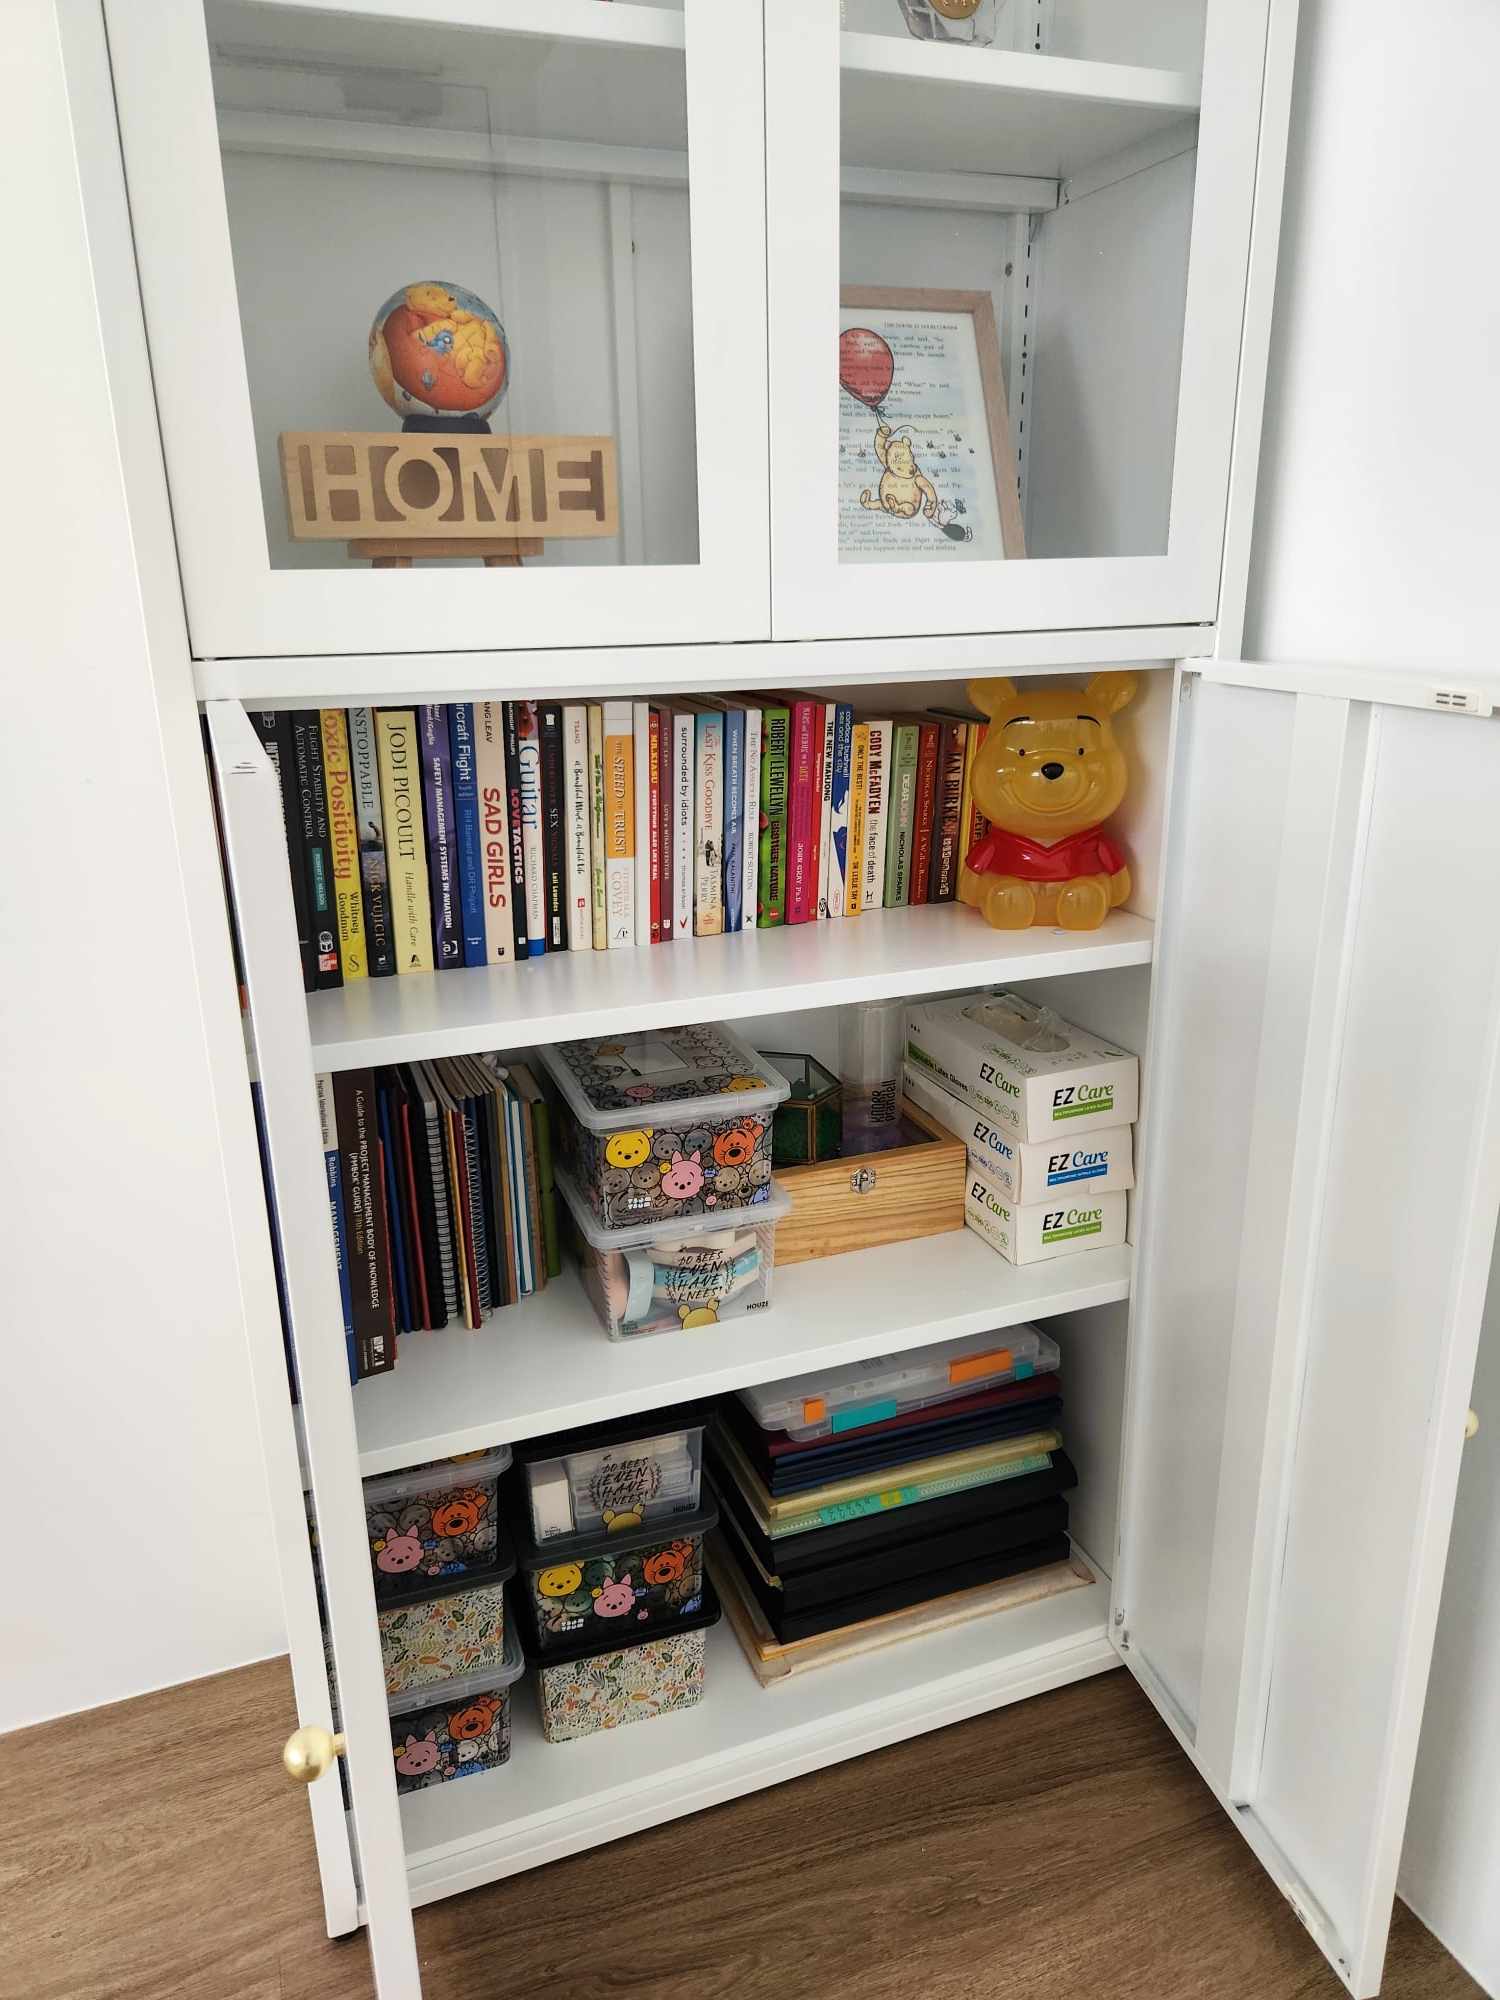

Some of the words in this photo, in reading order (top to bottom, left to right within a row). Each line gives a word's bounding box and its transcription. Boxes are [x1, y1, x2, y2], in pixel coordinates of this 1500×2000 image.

[303, 445, 602, 522] HOME
[455, 703, 469, 744] ircraft
[484, 702, 492, 719] ANG
[485, 720, 494, 743] LEAV
[704, 724, 716, 748] LAST
[770, 718, 785, 757] ROBERT
[826, 721, 834, 737] THE
[843, 711, 851, 742] candace
[309, 725, 319, 760] FLIGHT
[387, 723, 407, 771] JODI
[681, 727, 689, 783] surrounded
[825, 739, 834, 759] NEW
[869, 730, 882, 757] CODY
[432, 757, 442, 787] SAFETY
[456, 745, 473, 781] Flight
[703, 752, 717, 777] KISS
[730, 755, 738, 785] BREATH
[835, 759, 843, 774] city
[842, 745, 851, 778] bushnell
[295, 725, 309, 787] AUTOMATIC
[302, 789, 313, 839] CONTROL
[312, 765, 324, 814] STABILITY
[520, 746, 540, 830] Guitar
[614, 757, 625, 799] SPEED
[680, 785, 689, 798] by
[769, 760, 785, 816] LLEWELLYN
[823, 761, 833, 802] MAHJONG
[868, 760, 882, 815] McFADYEN
[435, 788, 447, 846] MANAGEMENT
[484, 787, 502, 835] SAD
[681, 799, 689, 827] idiots
[703, 779, 716, 831] GOODBYE
[942, 779, 961, 824] BURKE
[317, 817, 327, 838] AND
[329, 770, 354, 880] Positivity
[354, 706, 374, 809] NSTOPPABLE
[371, 894, 386, 947] VUJICIC
[393, 776, 416, 861] PICOULT
[550, 807, 559, 828] SEX
[614, 811, 626, 854] TRUST
[869, 819, 878, 831] the
[771, 820, 780, 863] BROTHER
[796, 842, 804, 862] JOHN
[868, 832, 879, 850] face
[868, 851, 876, 859] of
[897, 831, 905, 871] NICHOLAS
[439, 846, 449, 882] SYSTEMS
[487, 841, 507, 909] GIRLS
[866, 860, 877, 883] death
[405, 872, 416, 904] Handle
[443, 882, 450, 891] IN
[709, 868, 719, 910] TASMINA
[895, 870, 903, 901] SPARKS
[338, 892, 350, 942] Goodman
[350, 891, 360, 934] Whitney
[408, 905, 418, 925] with
[443, 893, 453, 929] AVIATION
[409, 927, 419, 947] Care
[979, 1062, 995, 1084] EZ
[994, 1072, 1021, 1099] Care
[1052, 1086, 1076, 1107] EZ
[1077, 1084, 1114, 1102] Care
[356, 1097, 365, 1117] Guide
[358, 1118, 365, 1127] to
[359, 1127, 368, 1139] the
[973, 1121, 990, 1143] EZ
[988, 1131, 1013, 1160] Care
[360, 1140, 370, 1173] PROJECT
[1047, 1153, 1070, 1174] EZ
[1072, 1150, 1109, 1168] Care
[351, 1185, 362, 1213] GUIDE)
[362, 1173, 375, 1234] MANAGEMENT
[971, 1181, 987, 1204] EZ
[985, 1193, 1010, 1222] Care
[1042, 1211, 1065, 1231] EZ
[1066, 1208, 1103, 1225] Care
[366, 1234, 375, 1251] BODY
[368, 1250, 376, 1261] OF
[695, 1250, 724, 1263] BEES
[368, 1261, 380, 1309] KNOWLEDGE
[677, 1273, 721, 1291] HAVE
[678, 1260, 723, 1279] EVEN
[746, 1300, 769, 1311] HOUZE
[601, 1466, 649, 1486] EVEN
[619, 1456, 649, 1471] BEES
[601, 1478, 648, 1498] HAVE
